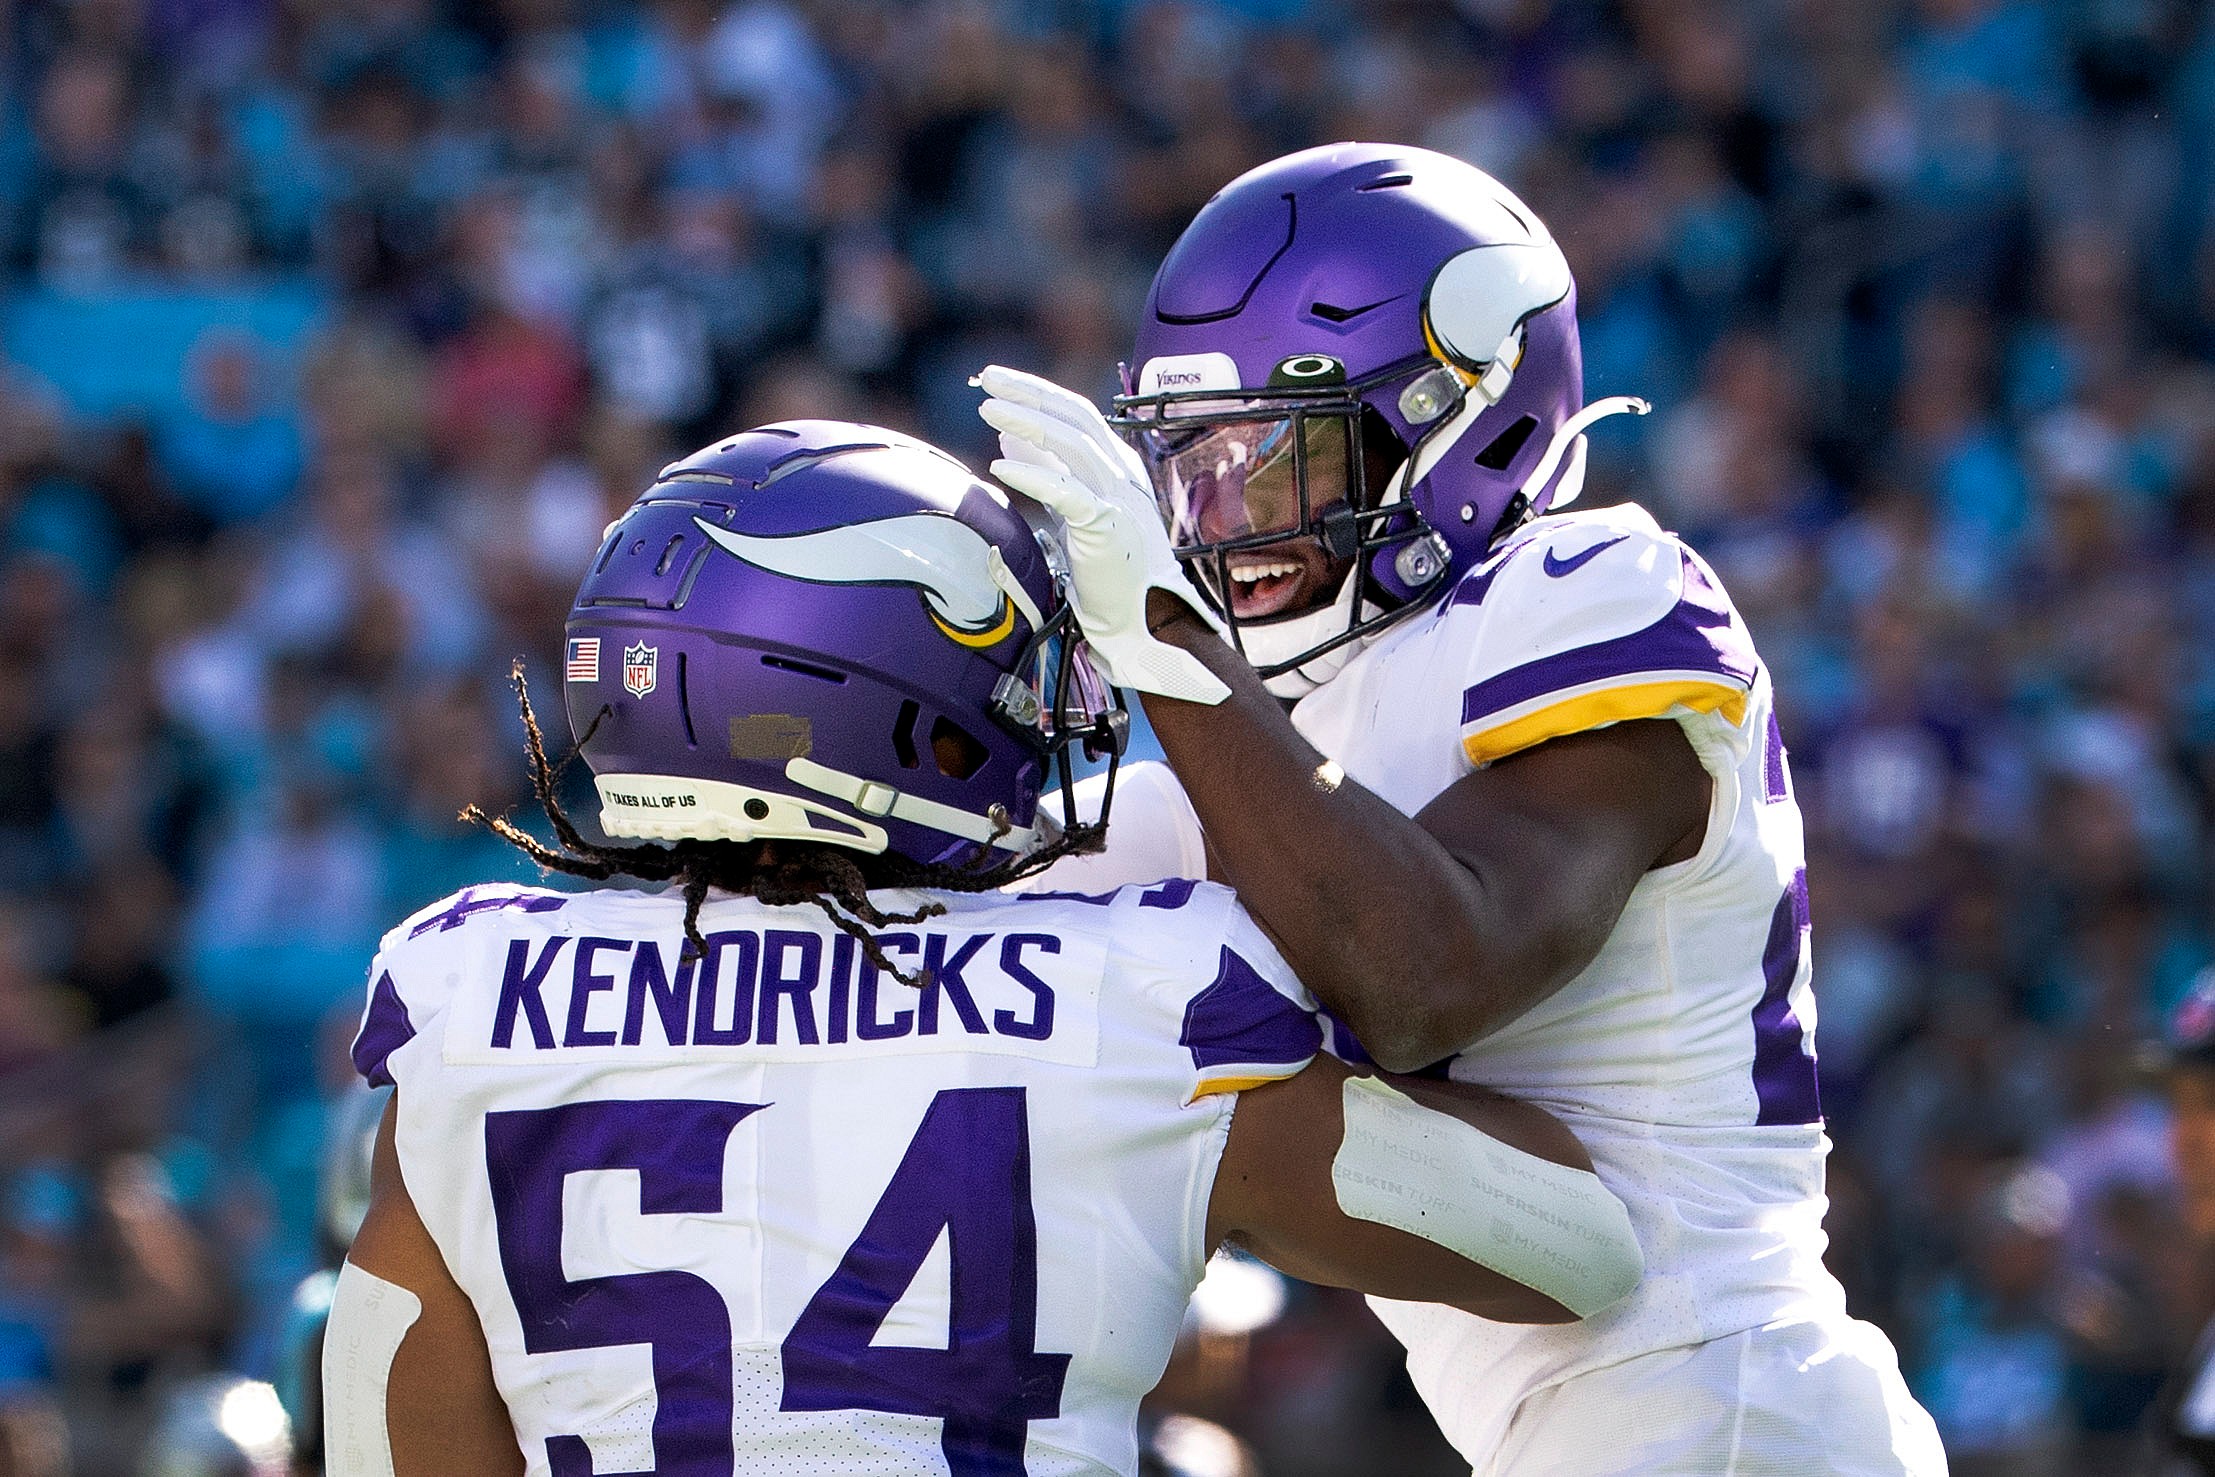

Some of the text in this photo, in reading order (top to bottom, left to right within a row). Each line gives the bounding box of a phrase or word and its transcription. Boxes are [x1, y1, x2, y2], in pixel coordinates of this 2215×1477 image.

[628, 667, 651, 687] NFL
[612, 792, 640, 807] TAKES
[641, 796, 661, 808] ALL
[661, 796, 676, 808] OF
[678, 795, 697, 807] US
[489, 929, 1062, 1050] KENDRICKS
[485, 1086, 1073, 1477] 54
